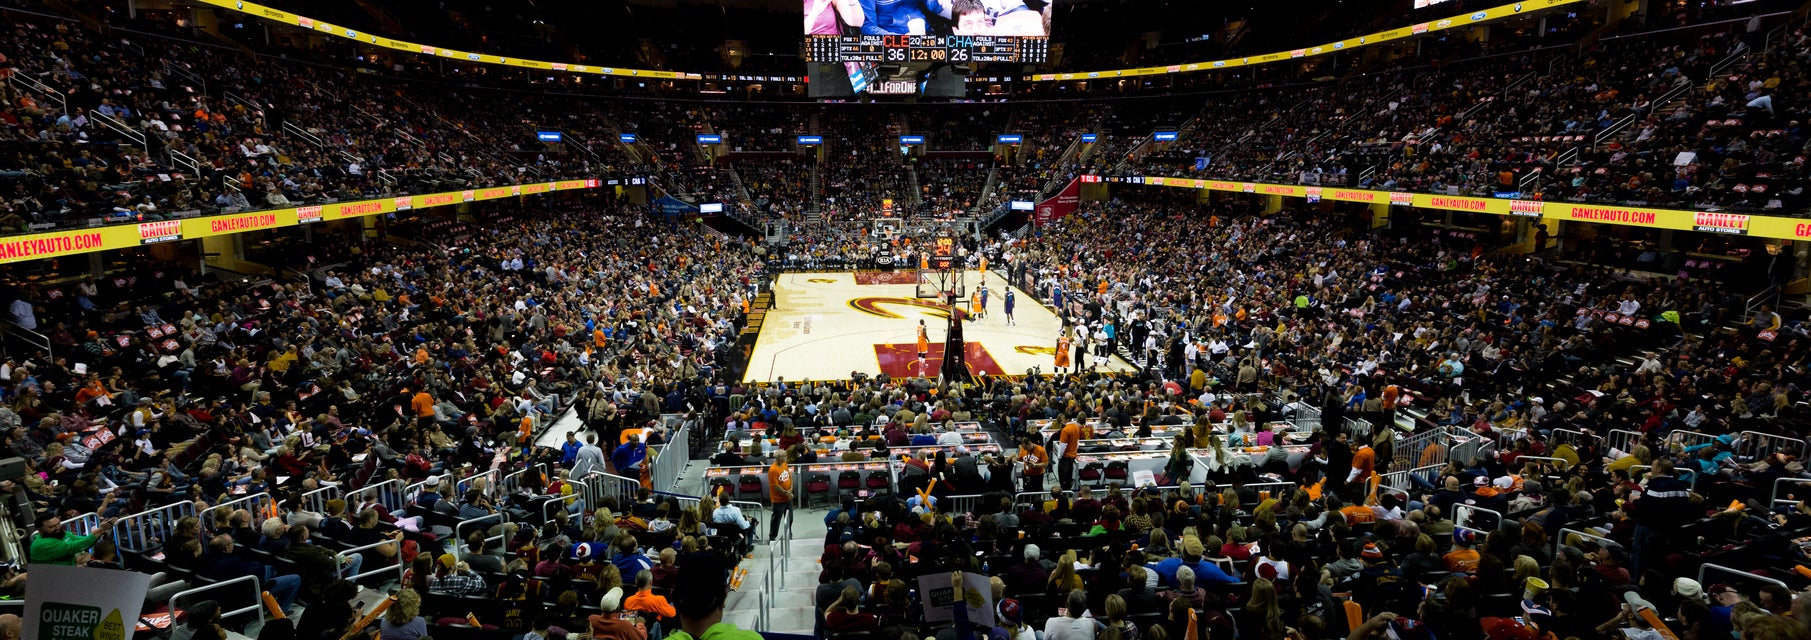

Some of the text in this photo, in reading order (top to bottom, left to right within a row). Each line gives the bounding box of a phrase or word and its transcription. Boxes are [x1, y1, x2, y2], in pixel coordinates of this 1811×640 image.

[884, 36, 909, 47] CLE
[910, 37, 920, 45] 2Q
[947, 36, 972, 47] CHA
[888, 49, 905, 60] 36
[911, 50, 946, 60] 12:00
[951, 49, 968, 60] 26
[1336, 191, 1374, 200] GANLEYAUTO.COM
[340, 202, 381, 216] GANLEYAUTO.COM
[1432, 198, 1486, 210] GANLEYAUTO.COM
[1511, 200, 1544, 212] GANLEY
[1572, 208, 1655, 224] GANLEYAUTO.COM
[1696, 212, 1746, 228] GANLEY
[141, 220, 179, 238] GANLEY
[212, 214, 276, 232] GANLEYAUTO.COM
[42, 610, 99, 624] QUAKER
[53, 626, 89, 638] STEAK
[104, 621, 122, 632] BEST
